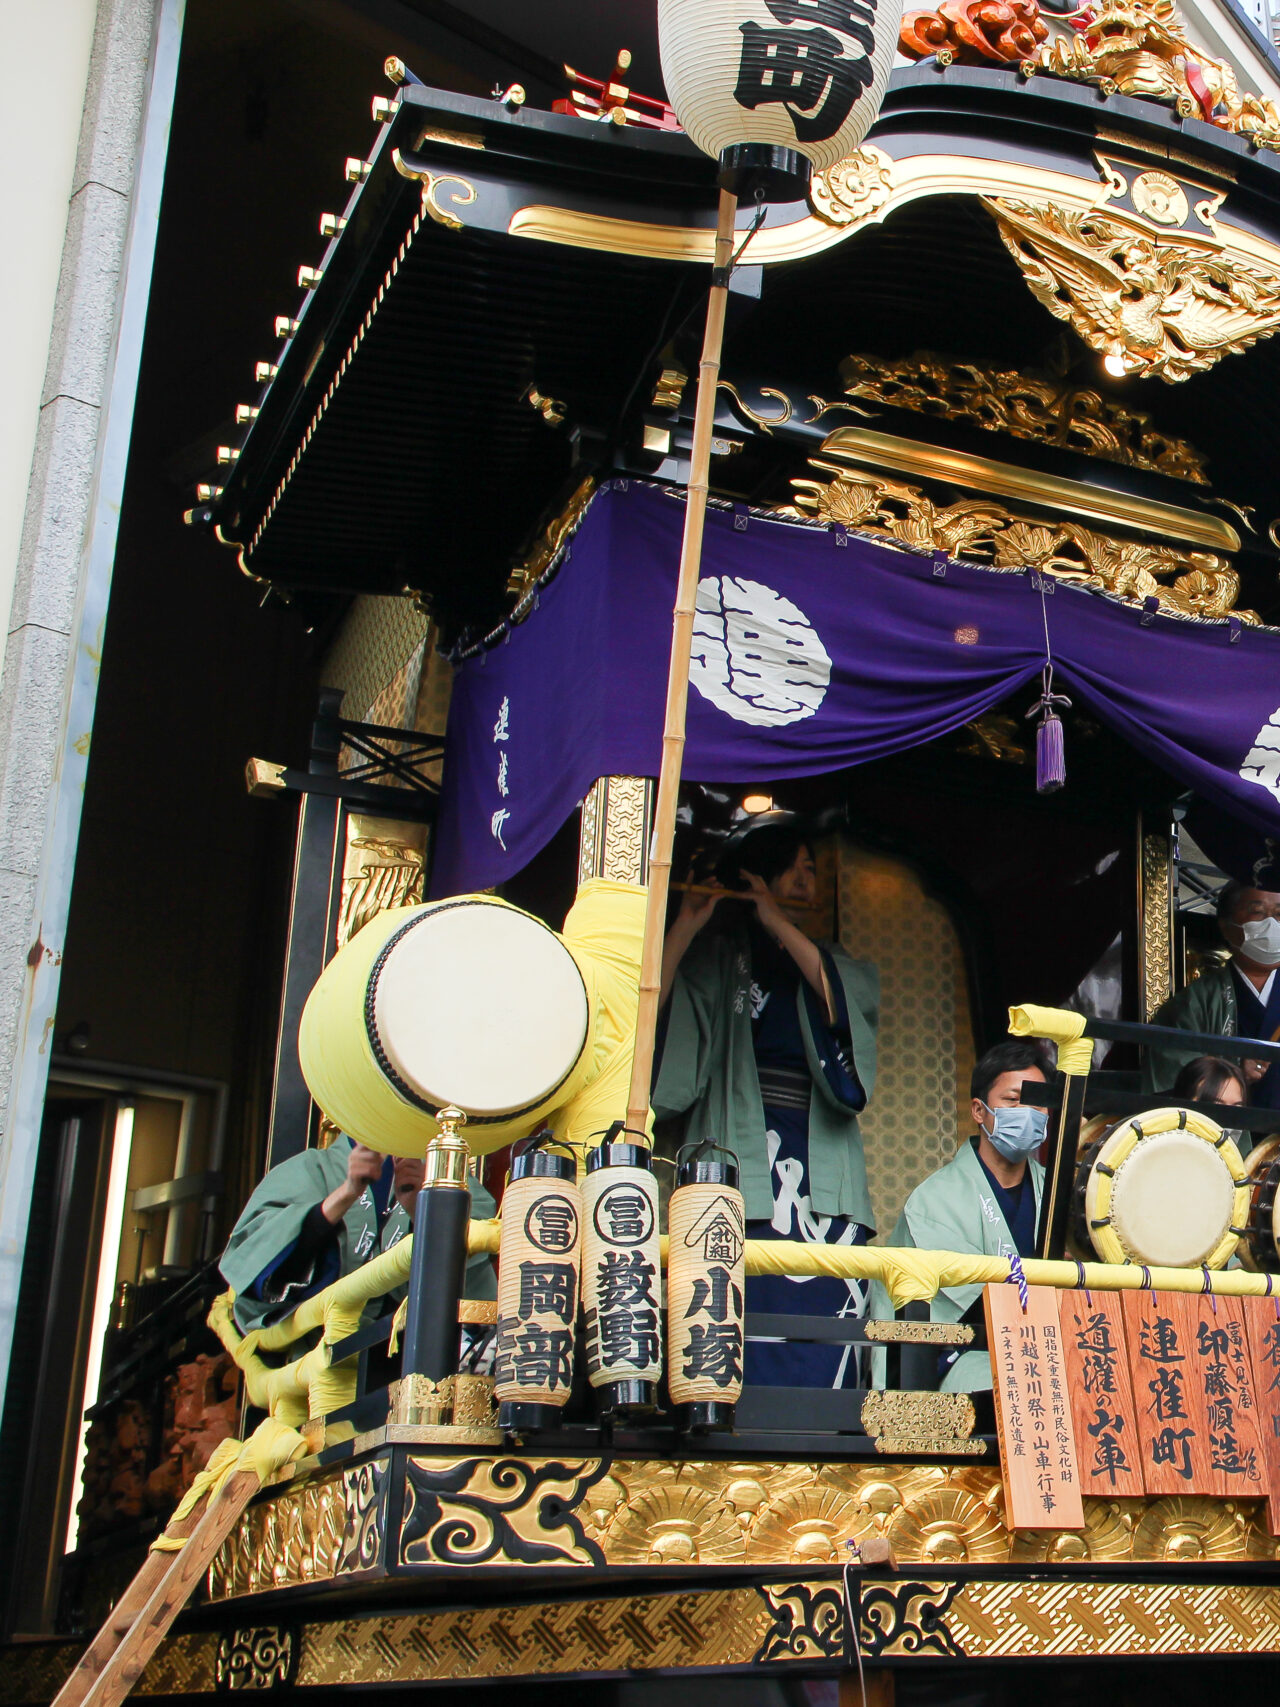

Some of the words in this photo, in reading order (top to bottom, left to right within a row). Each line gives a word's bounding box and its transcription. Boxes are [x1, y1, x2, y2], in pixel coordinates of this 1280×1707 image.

[514, 1260, 578, 1391] 岡部
[682, 1266, 743, 1388] 小塚
[1001, 1325, 1026, 1457] ユネスコ無形文化遺産
[1043, 1325, 1073, 1483] 国指定重要無形民俗文化財
[1074, 1312, 1132, 1487] 道灌の山車
[1138, 1316, 1197, 1480] 連雀町
[1019, 1325, 1057, 1514] 川越氷川祭の山車行事
